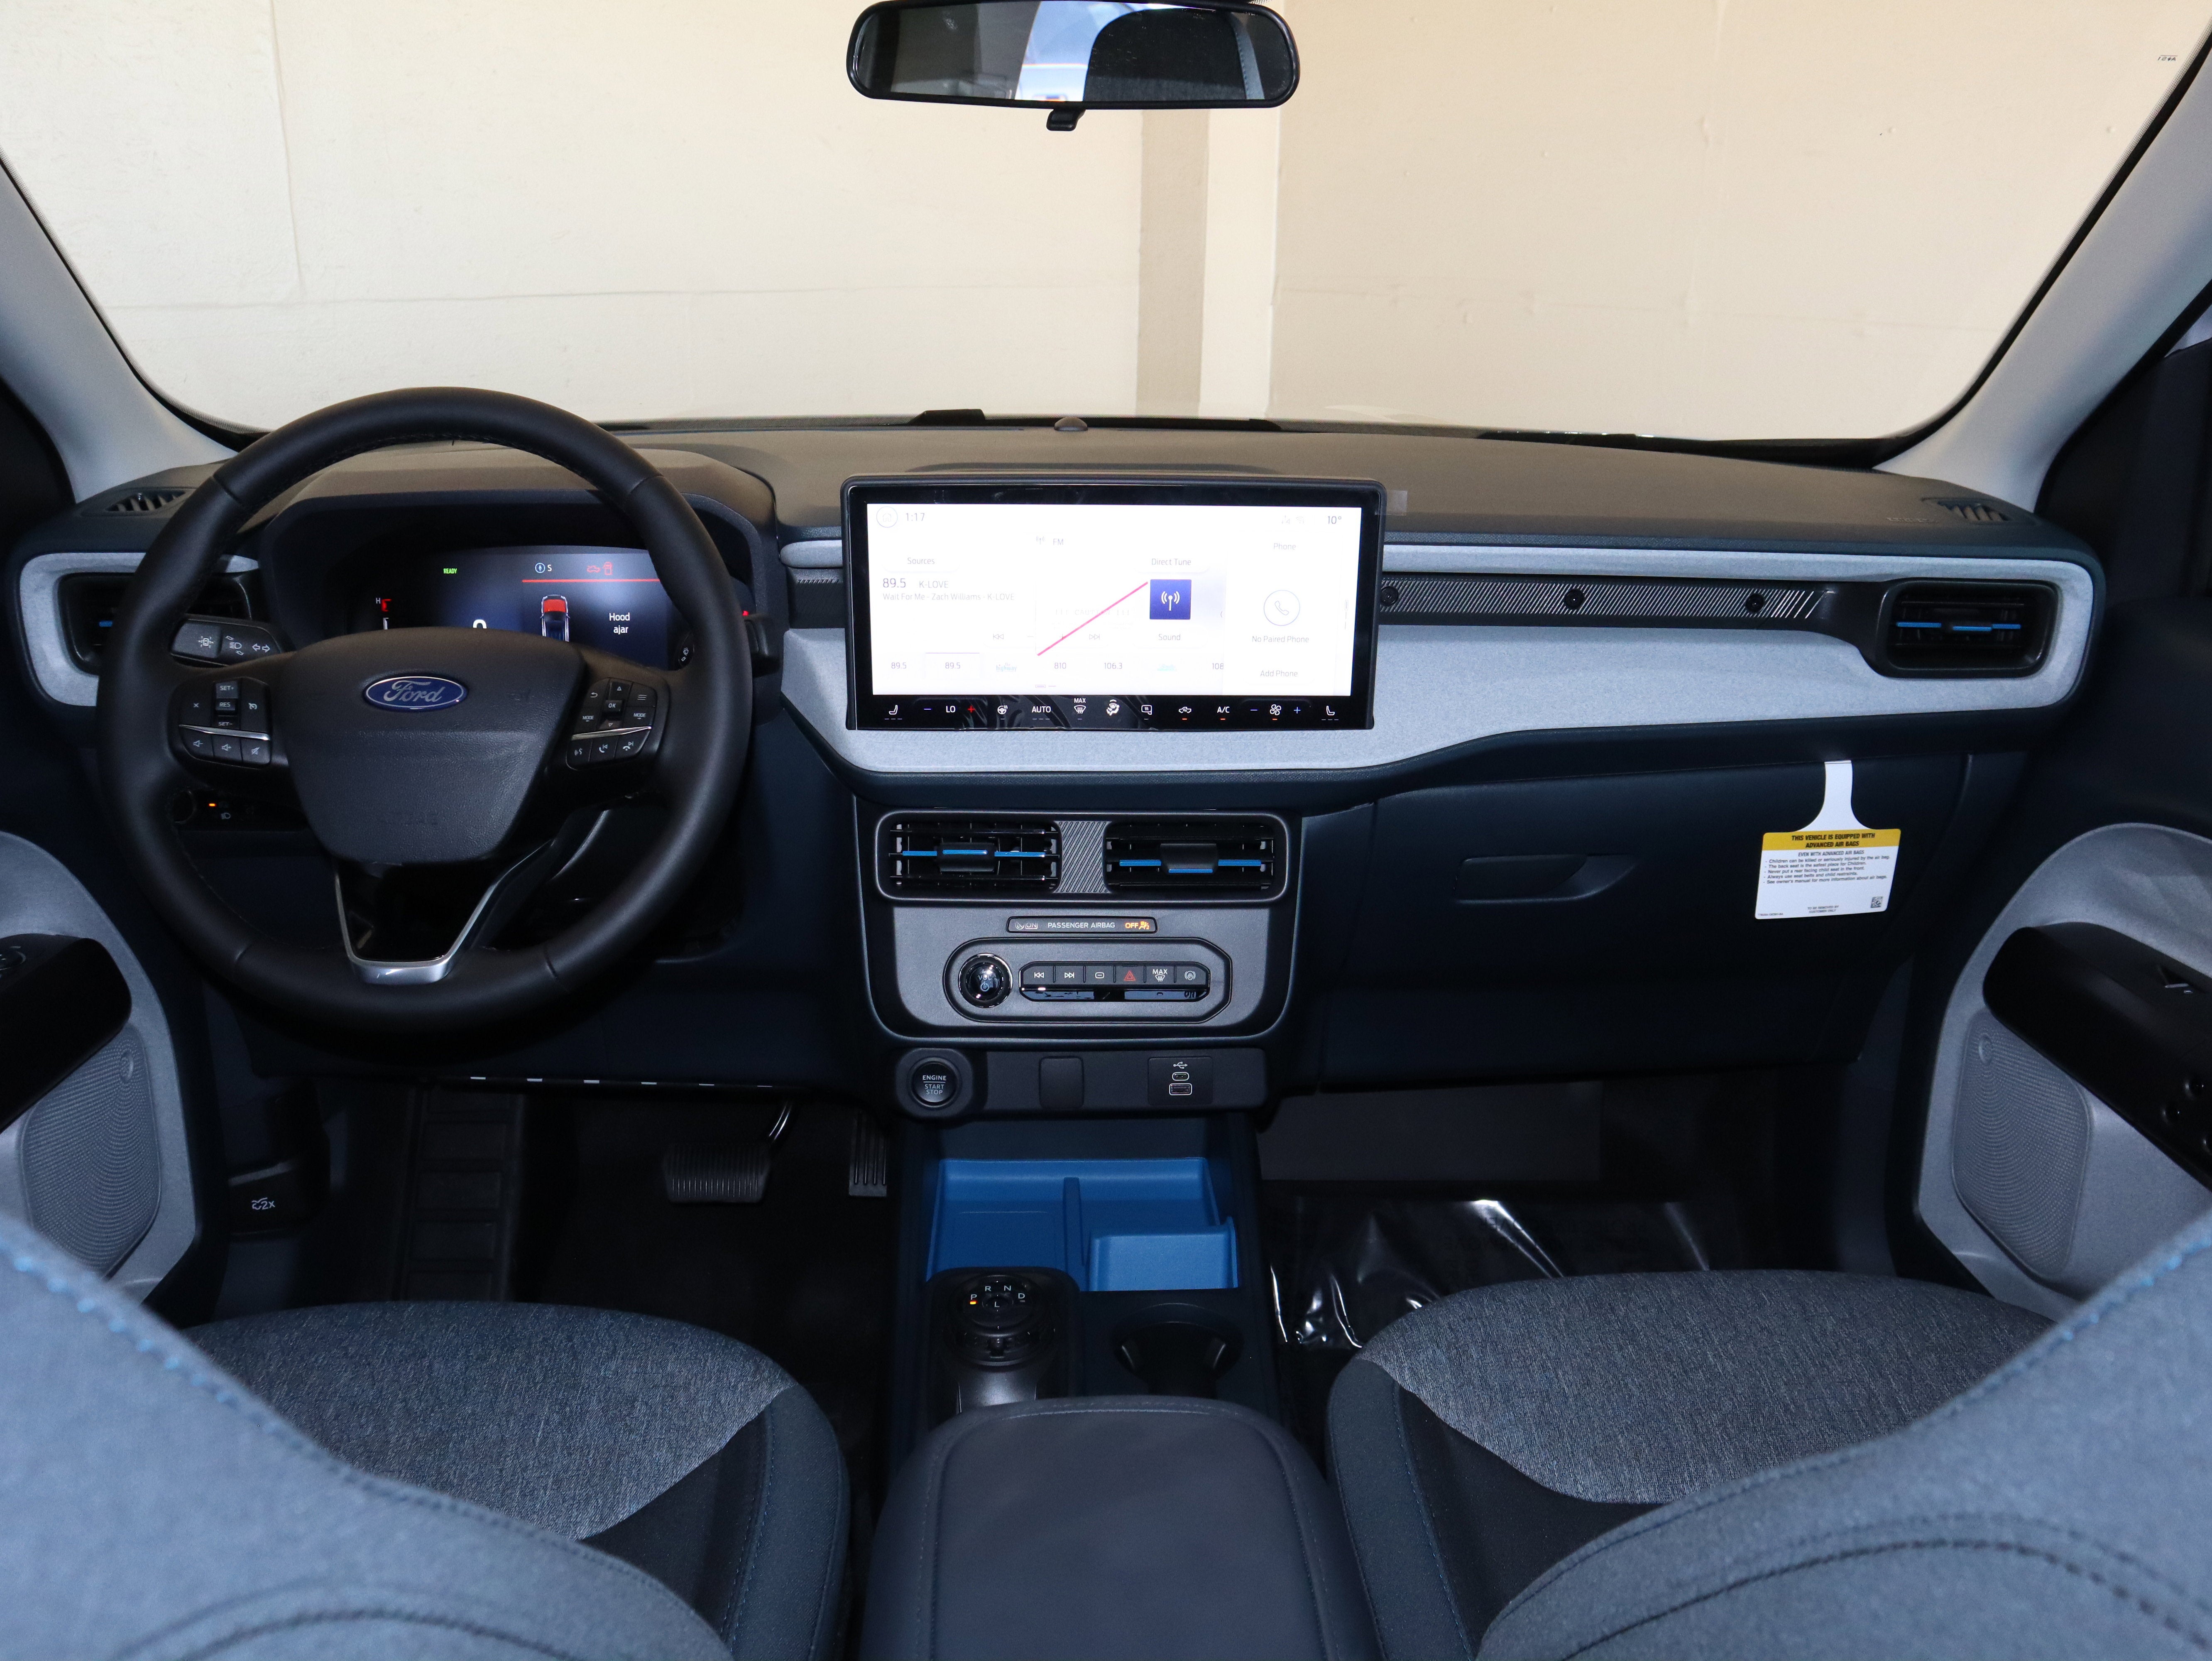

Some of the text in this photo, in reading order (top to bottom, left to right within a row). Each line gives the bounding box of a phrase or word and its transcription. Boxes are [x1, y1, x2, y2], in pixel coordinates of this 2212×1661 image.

[905, 512, 925, 522] 1:17
[1327, 515, 1342, 524] 10°
[883, 578, 906, 588] 89.5
[609, 612, 630, 622] Hood
[613, 625, 629, 634] ajar
[383, 680, 445, 702] Ford
